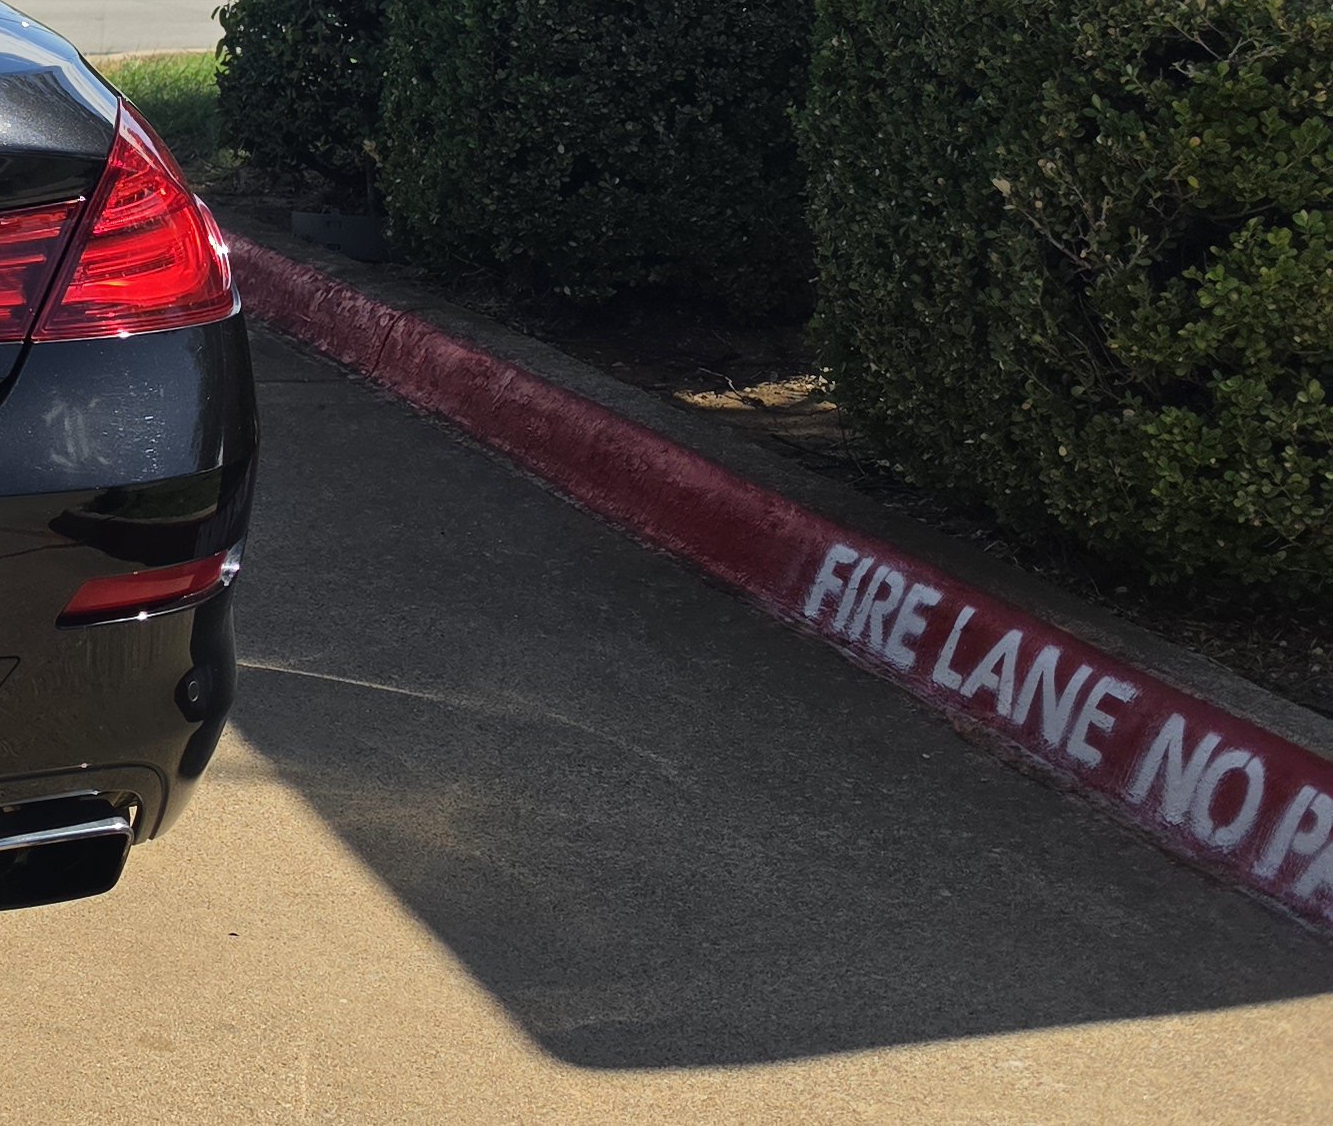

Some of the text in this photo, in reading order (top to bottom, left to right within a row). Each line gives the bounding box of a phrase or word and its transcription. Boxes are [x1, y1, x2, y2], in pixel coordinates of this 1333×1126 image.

[803, 543, 942, 673] FIRE
[931, 605, 1138, 769] LANE
[1126, 713, 1266, 853] NO
